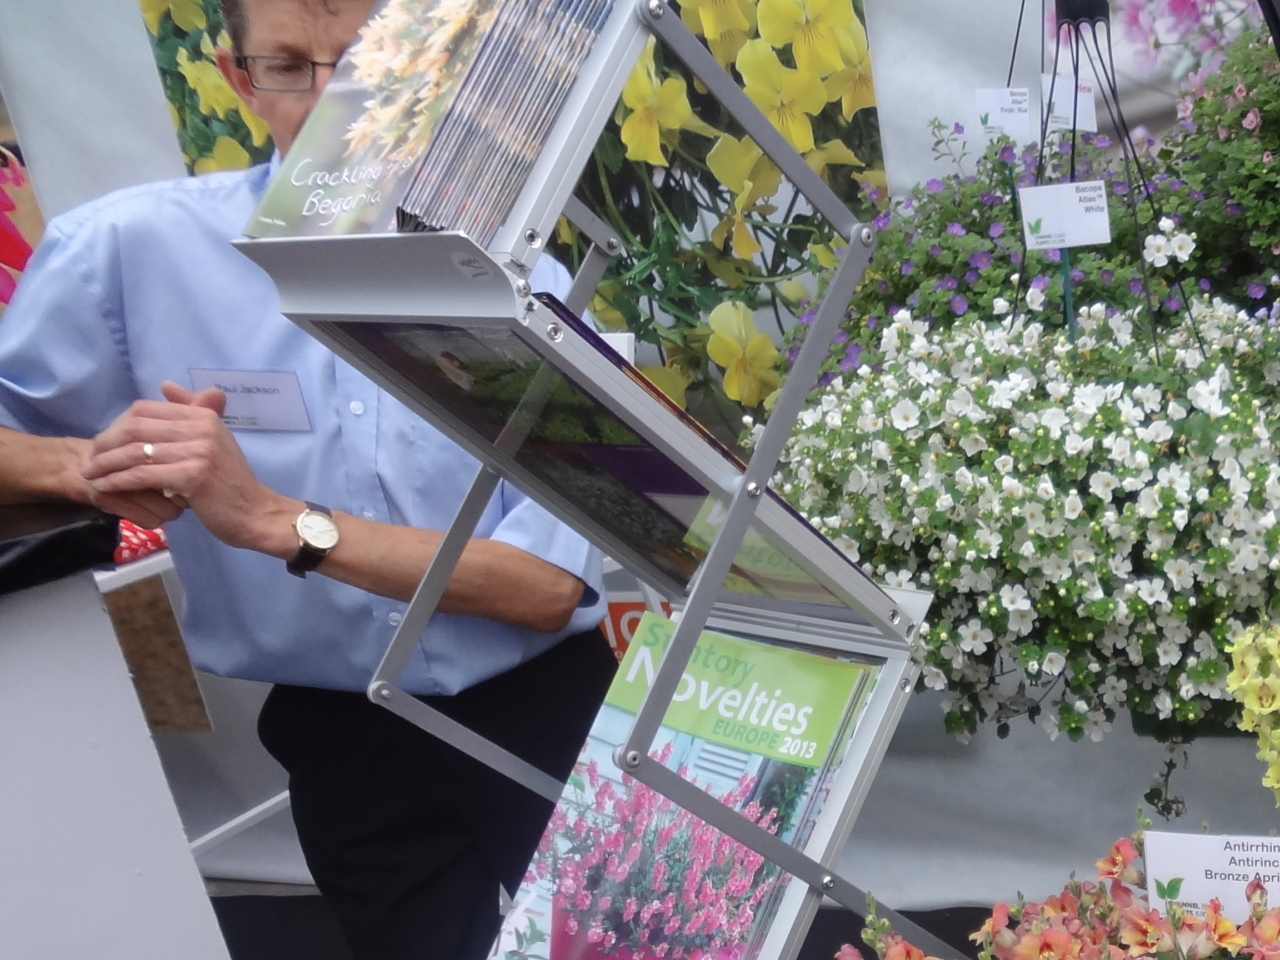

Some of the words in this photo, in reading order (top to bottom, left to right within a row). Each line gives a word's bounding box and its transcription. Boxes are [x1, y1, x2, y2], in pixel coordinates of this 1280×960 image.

[291, 158, 382, 189] Crackling
[1074, 185, 1103, 194] Bacopa
[302, 189, 382, 227] Begonia
[1083, 205, 1105, 214] White
[711, 718, 781, 751] EUROPE
[778, 736, 818, 760] 2013
[1204, 869, 1250, 882] Bronze
